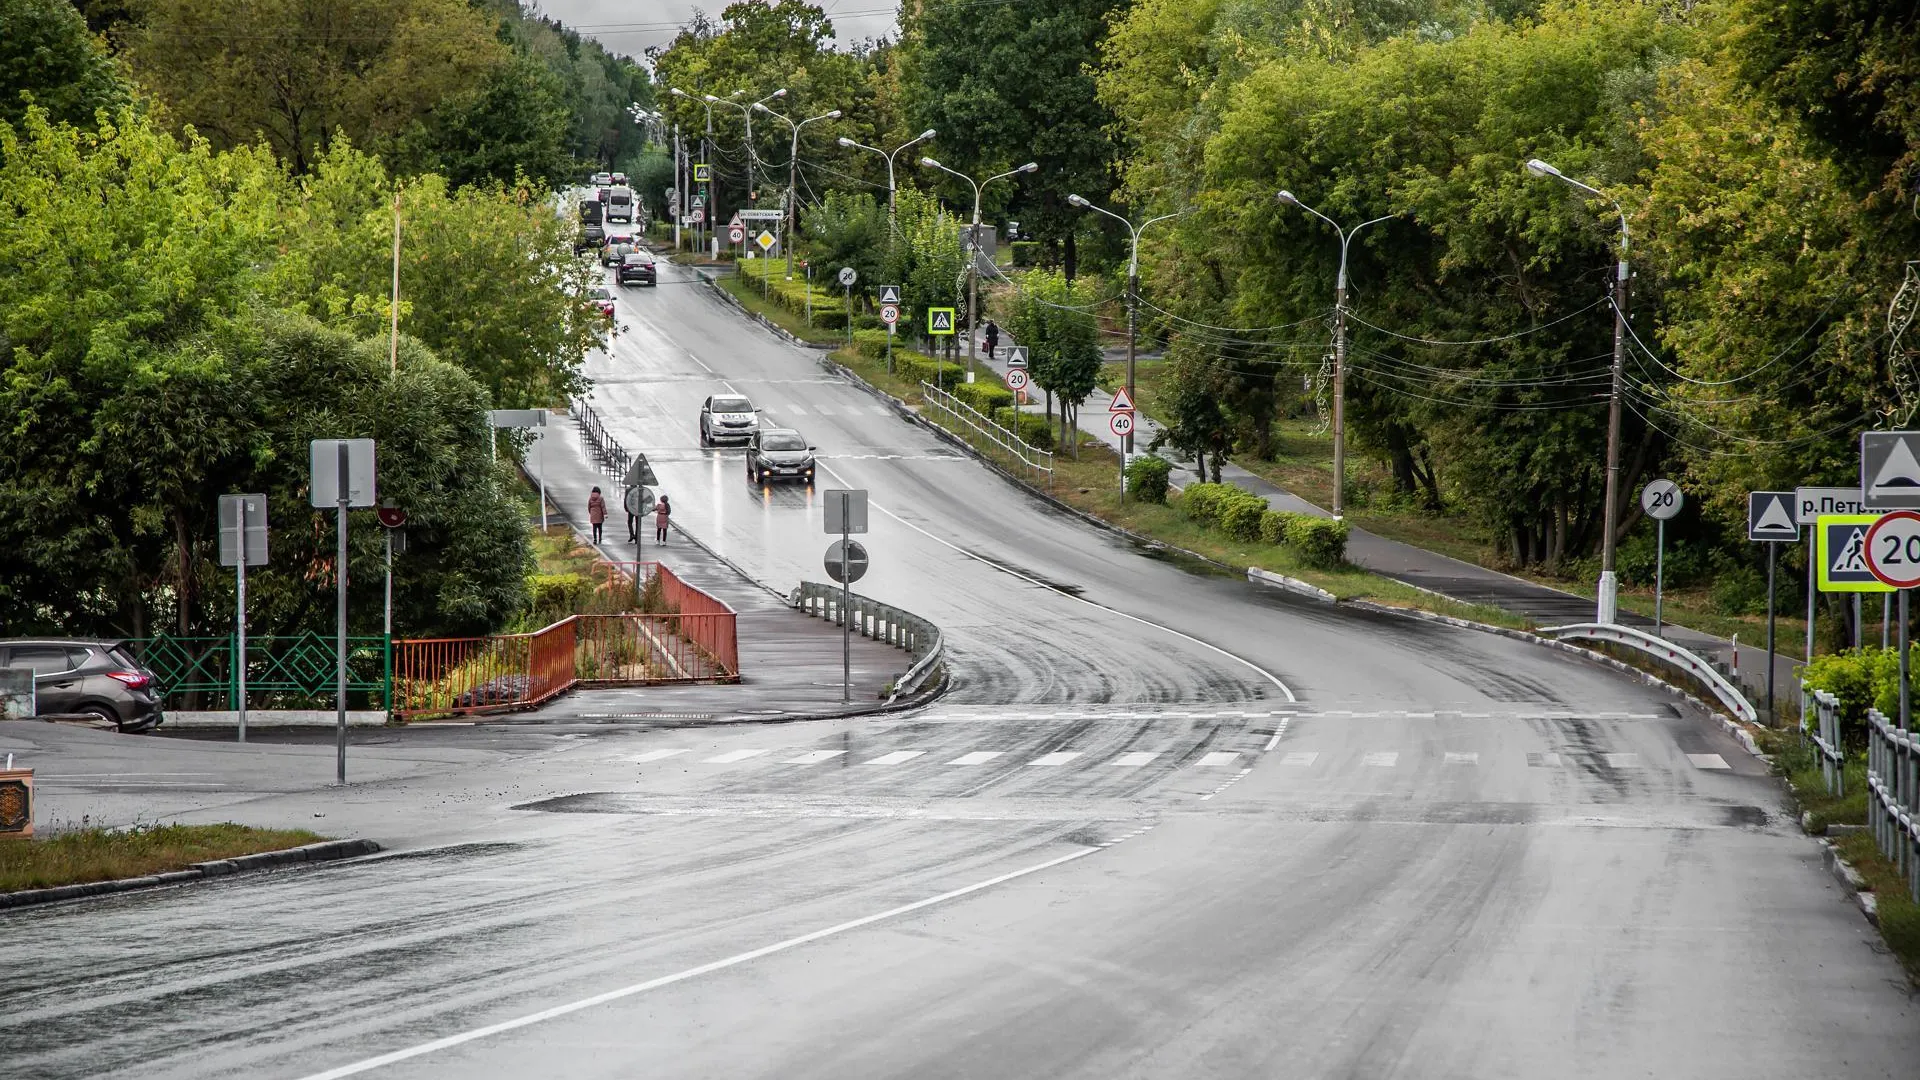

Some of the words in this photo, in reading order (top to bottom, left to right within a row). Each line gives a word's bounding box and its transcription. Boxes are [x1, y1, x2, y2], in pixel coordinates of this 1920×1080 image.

[732, 231, 741, 239] 40
[885, 310, 896, 318] 20
[1011, 375, 1023, 384] 20
[1115, 419, 1129, 429] 40
[1652, 492, 1674, 507] 20
[1882, 535, 1920, 565] 20
